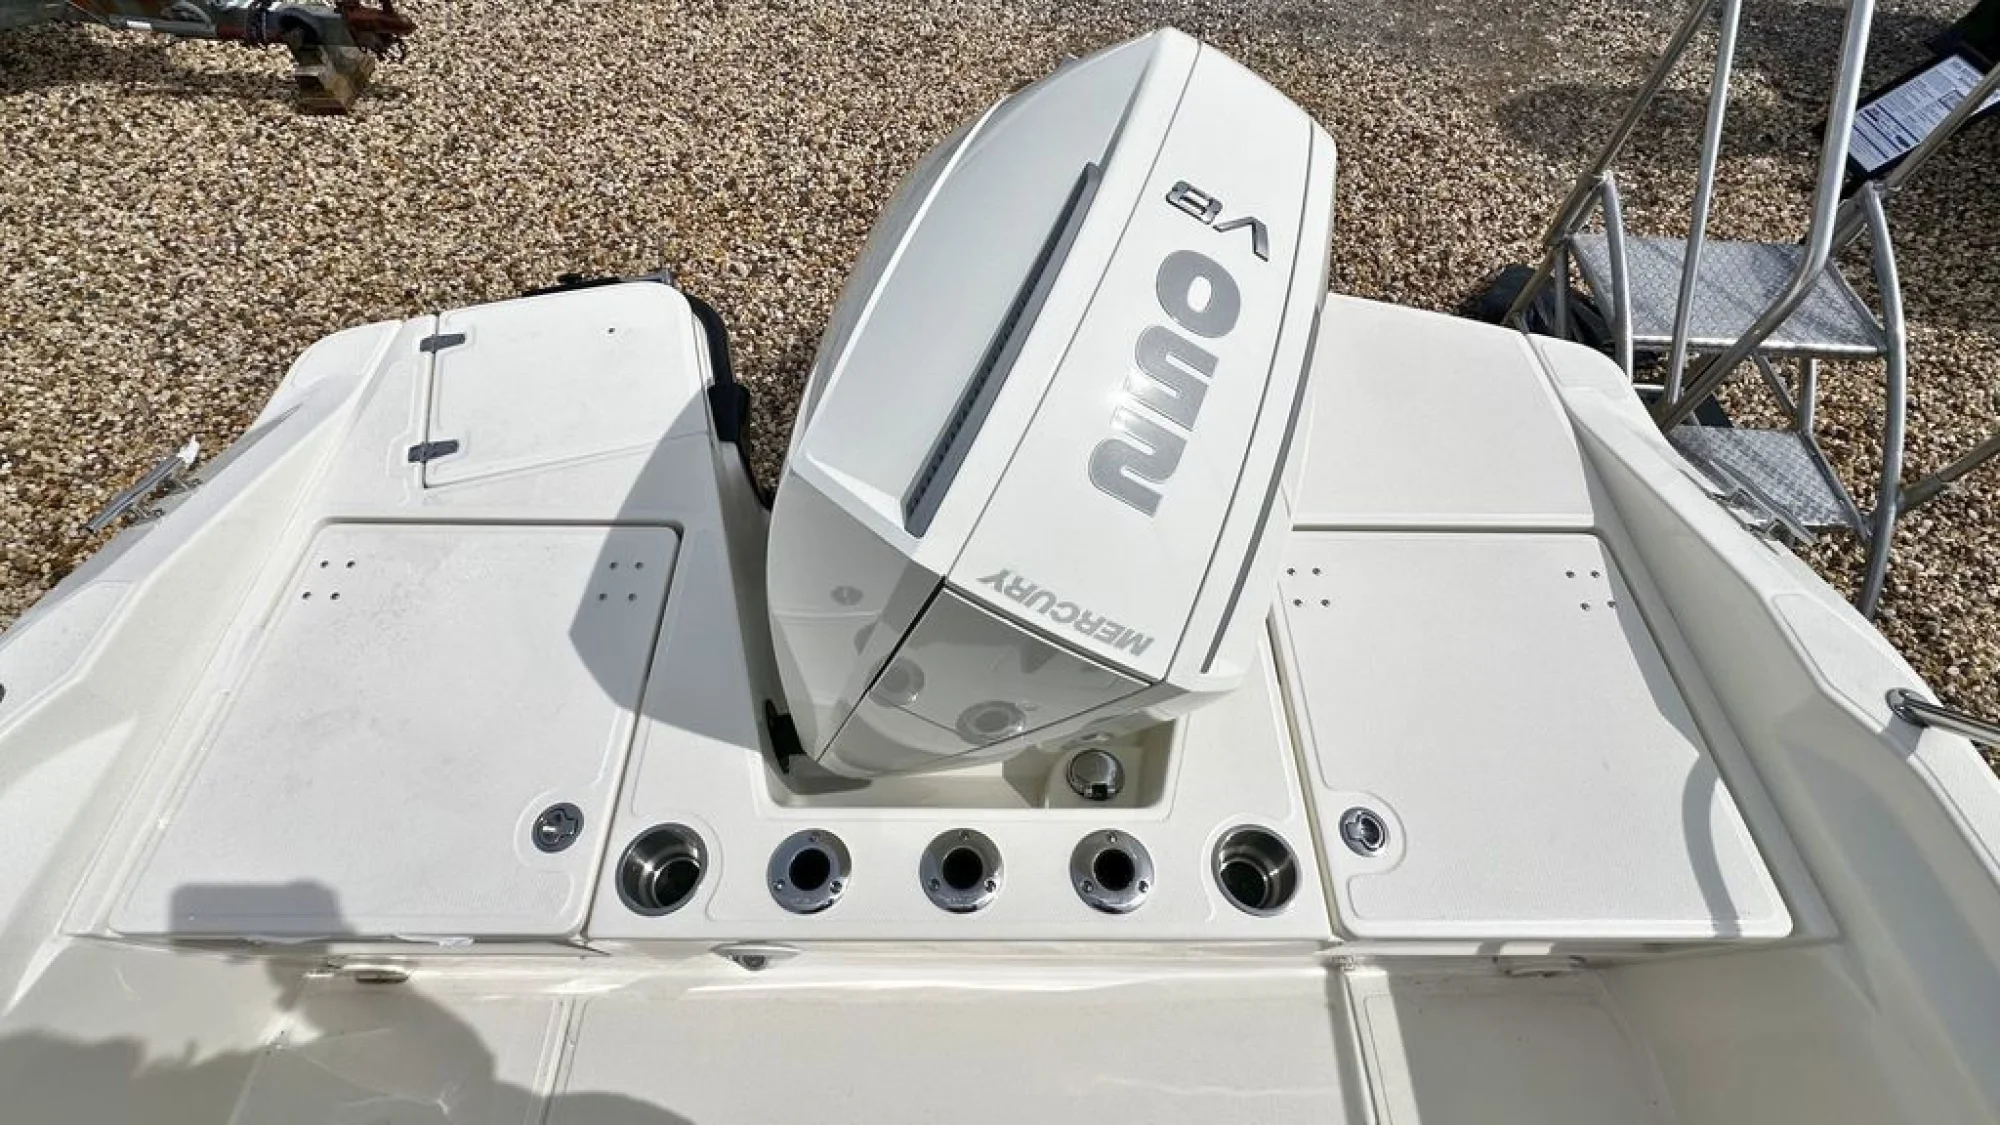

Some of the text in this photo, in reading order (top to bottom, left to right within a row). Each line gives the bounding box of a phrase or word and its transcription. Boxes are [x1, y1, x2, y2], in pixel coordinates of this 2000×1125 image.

[1166, 179, 1269, 262] V8
[1087, 249, 1241, 518] 250
[976, 569, 1155, 656] MERCURY
